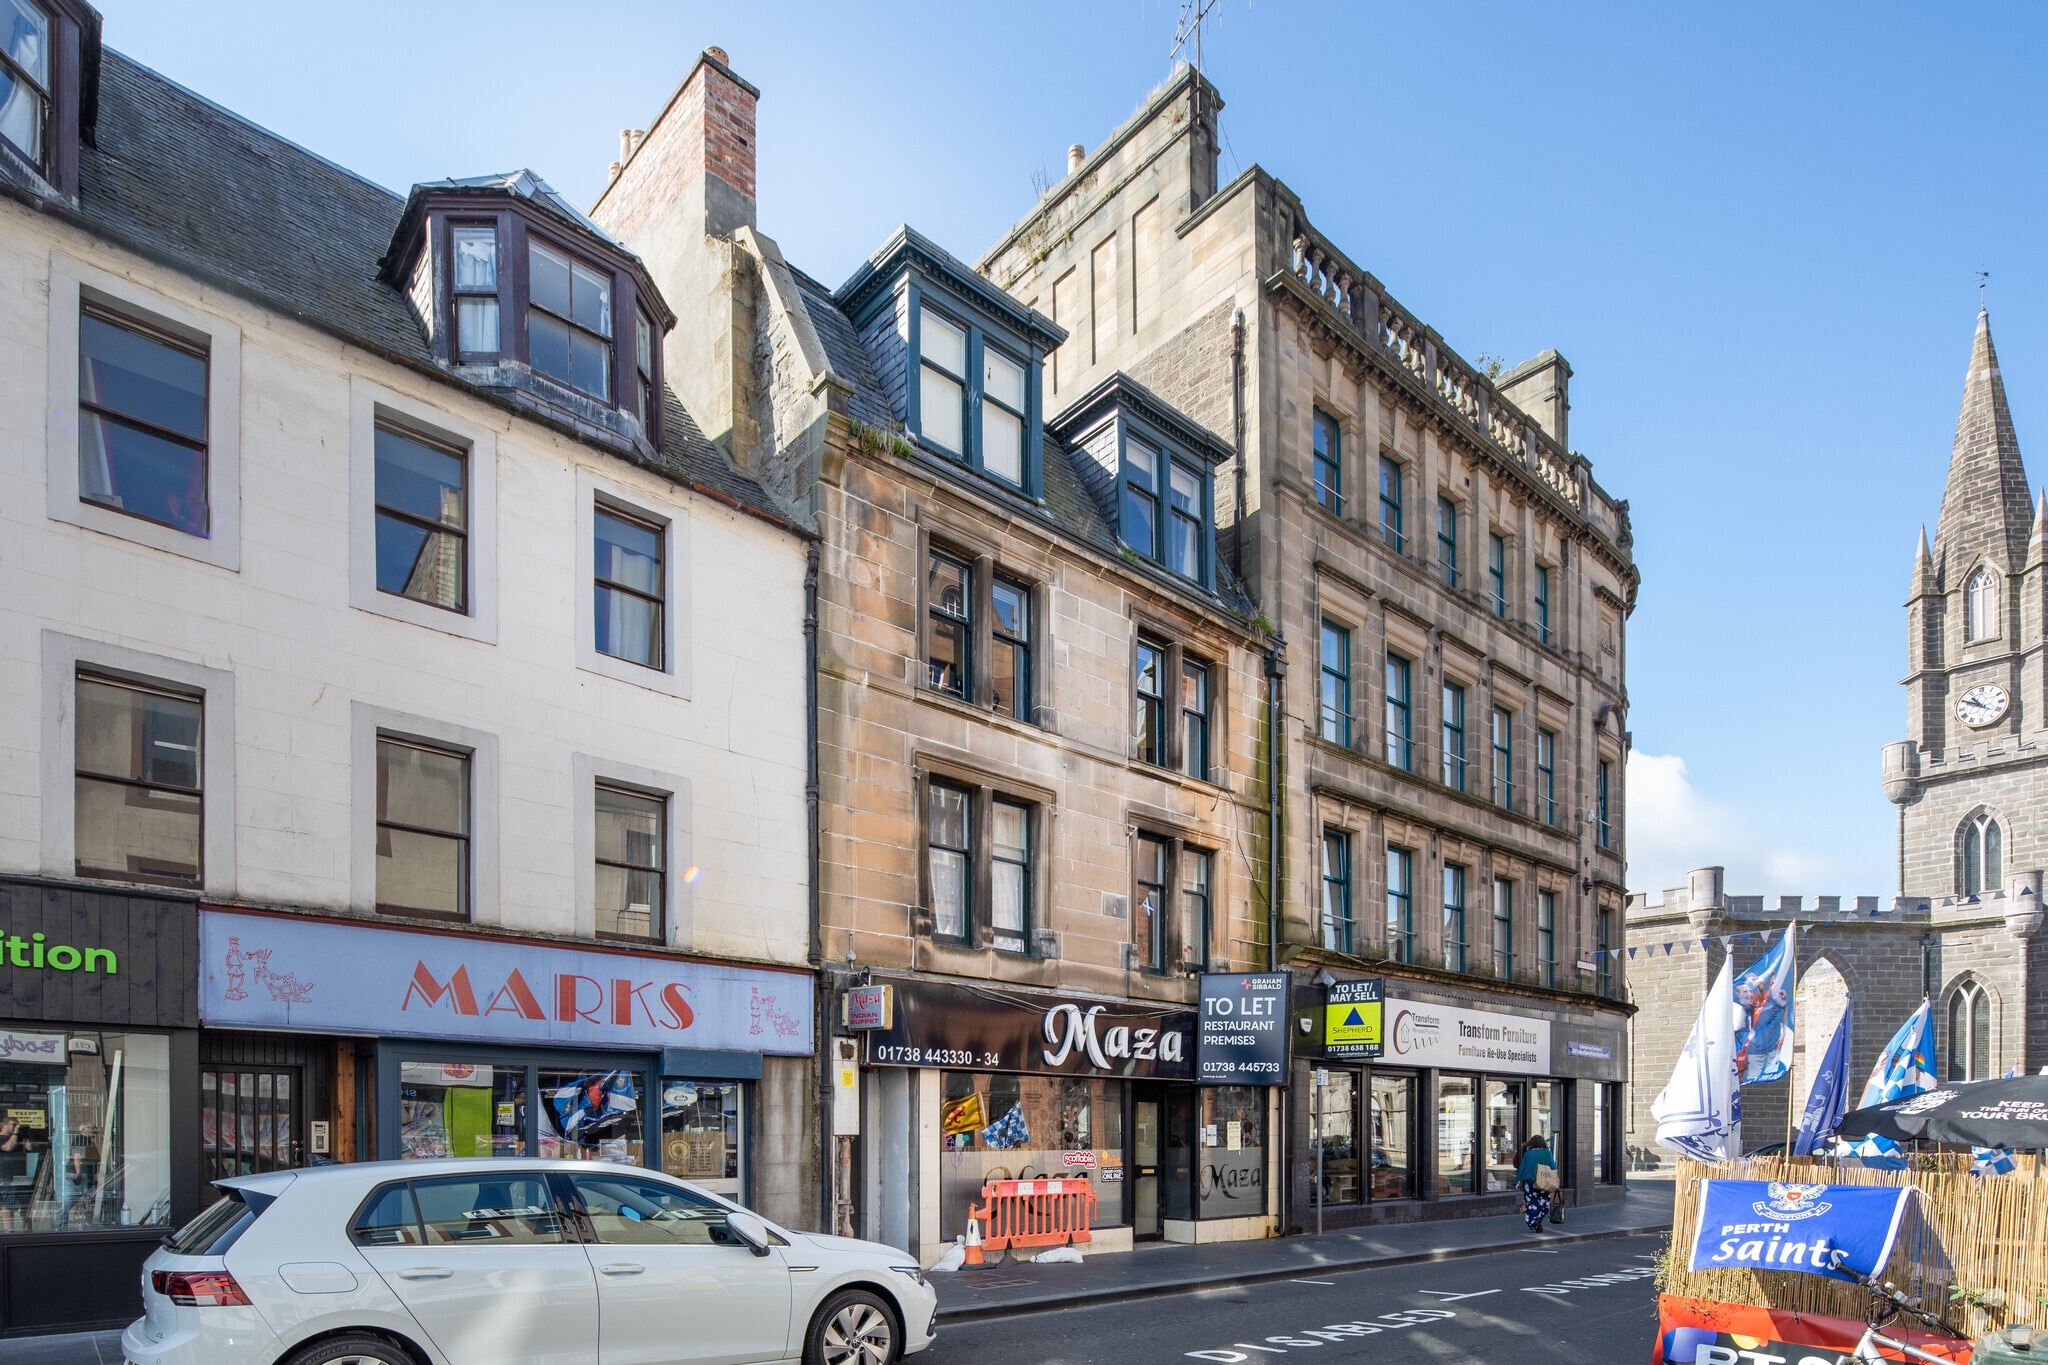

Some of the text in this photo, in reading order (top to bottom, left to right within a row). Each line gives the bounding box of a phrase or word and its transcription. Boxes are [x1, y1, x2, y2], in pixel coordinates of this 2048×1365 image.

[1335, 982, 1374, 994] TO LET/
[401, 959, 694, 1031] MARKS
[849, 991, 881, 1012] Maza
[1330, 991, 1379, 1003] MAY SELL
[1205, 997, 1277, 1016] TO LET
[1411, 1012, 1440, 1025] Transform
[1204, 1021, 1275, 1031] RESTAURANT
[1458, 1020, 1537, 1045] Transform Furniture
[1043, 1003, 1184, 1070] Maza
[1203, 1035, 1256, 1046] PREMISES
[1350, 1044, 1364, 1052] 638
[1458, 1044, 1537, 1063] Furniture Re-Use Specialists
[878, 1045, 921, 1062] 01738
[925, 1048, 972, 1065] 443330
[984, 1052, 1000, 1066] 34
[1203, 1062, 1280, 1072] 01738 445733
[1998, 1101, 2045, 1109] KEEP
[1961, 1111, 2010, 1120] YOUR
[1064, 1152, 1095, 1164] scoffable
[1200, 1163, 1261, 1201] Maza
[1721, 1223, 1790, 1236] PERTH
[1184, 1308, 1457, 1363] DISABLED
